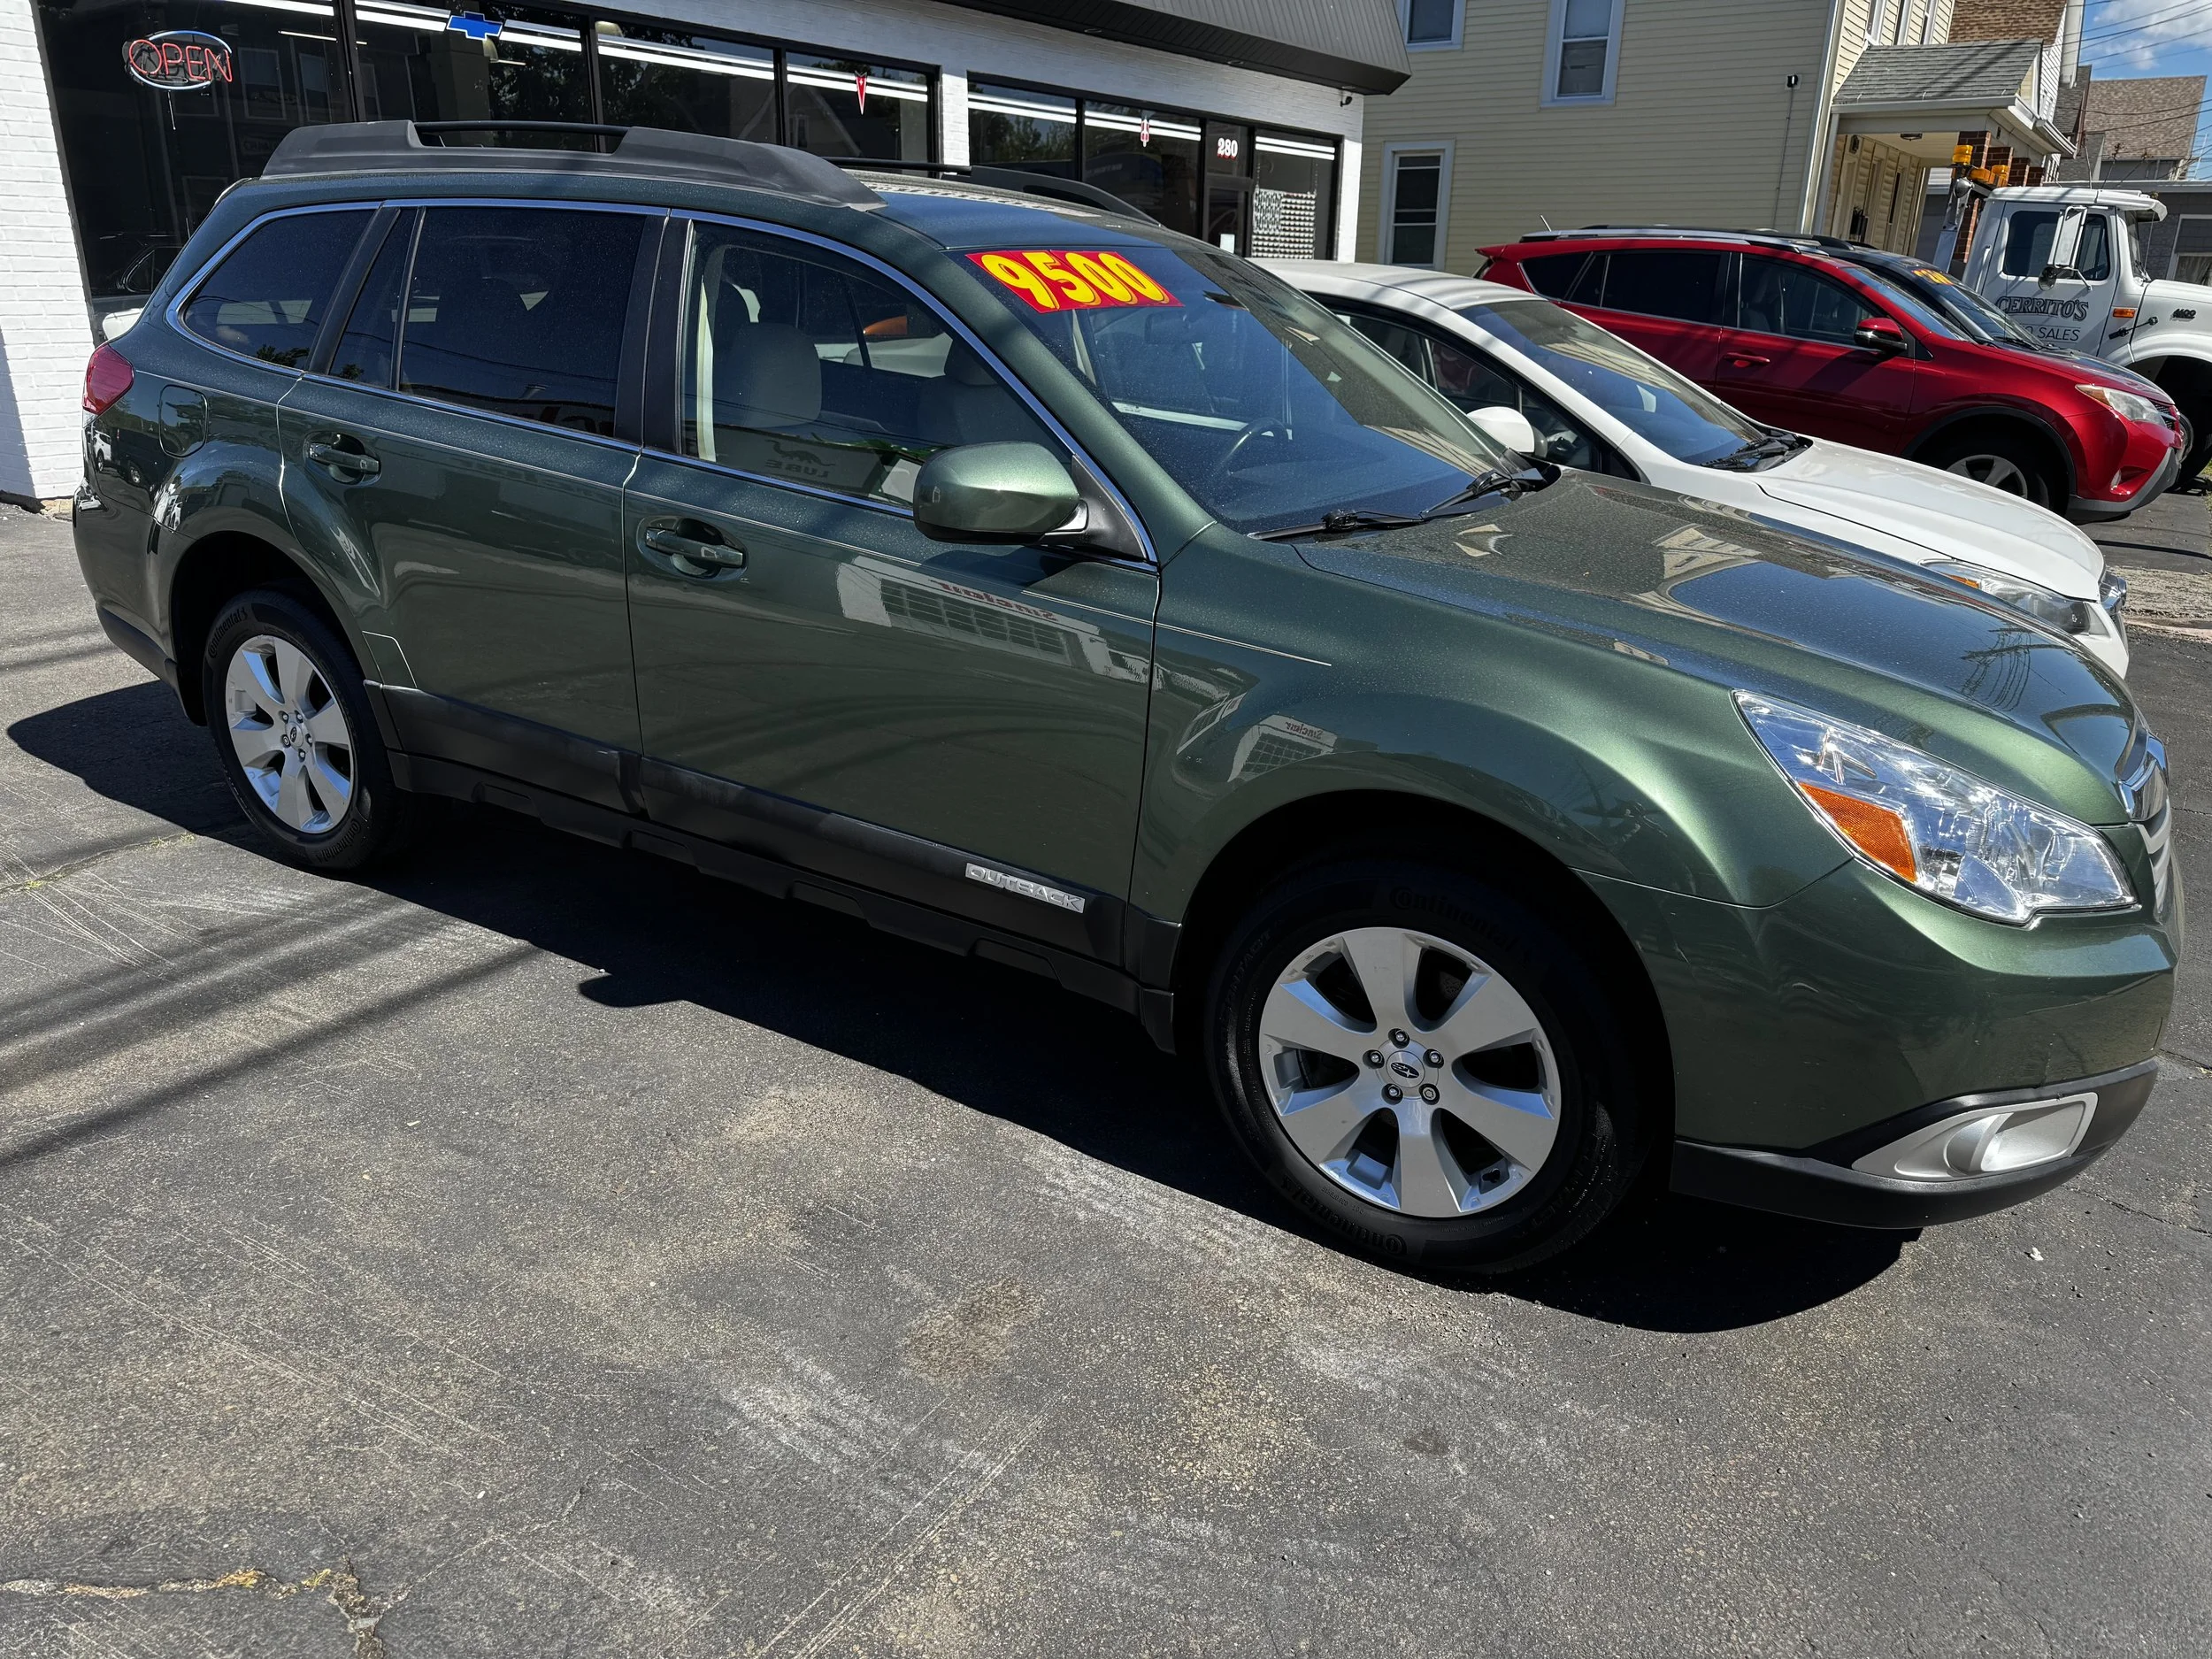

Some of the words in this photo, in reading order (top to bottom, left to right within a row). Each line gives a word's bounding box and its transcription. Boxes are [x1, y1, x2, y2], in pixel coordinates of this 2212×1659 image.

[129, 39, 232, 81] OPEN
[1217, 137, 1238, 158] 280
[980, 251, 1170, 310] 9500
[1995, 296, 2088, 321] CERRITO'S
[2037, 326, 2081, 342] SALES
[968, 864, 1084, 912] OUTBACK
